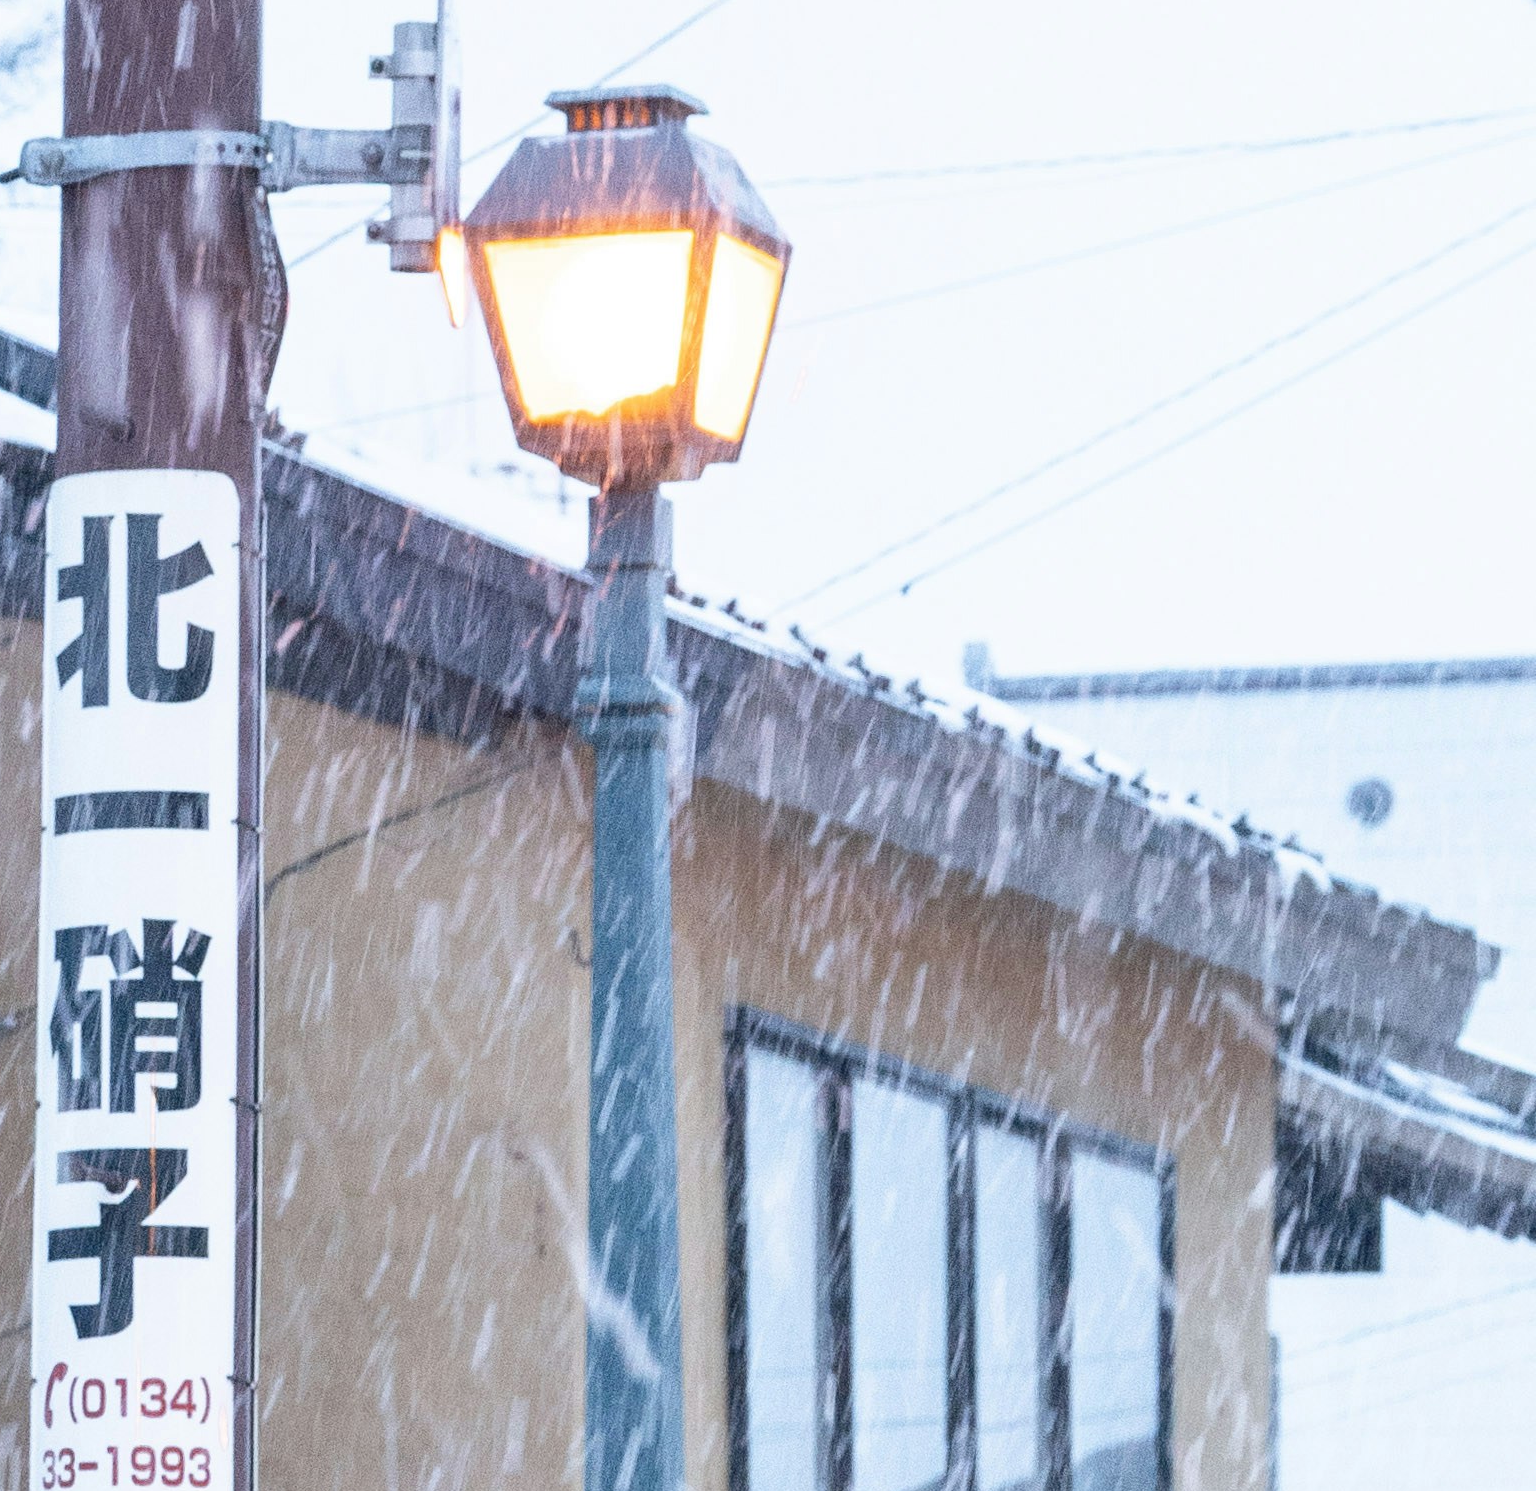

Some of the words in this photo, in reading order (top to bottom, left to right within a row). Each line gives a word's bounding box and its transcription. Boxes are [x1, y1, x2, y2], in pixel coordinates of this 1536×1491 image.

[48, 512, 215, 1340] 北一硝子
[69, 1377, 212, 1424] (0134)
[42, 1446, 212, 1490] 33-1993
